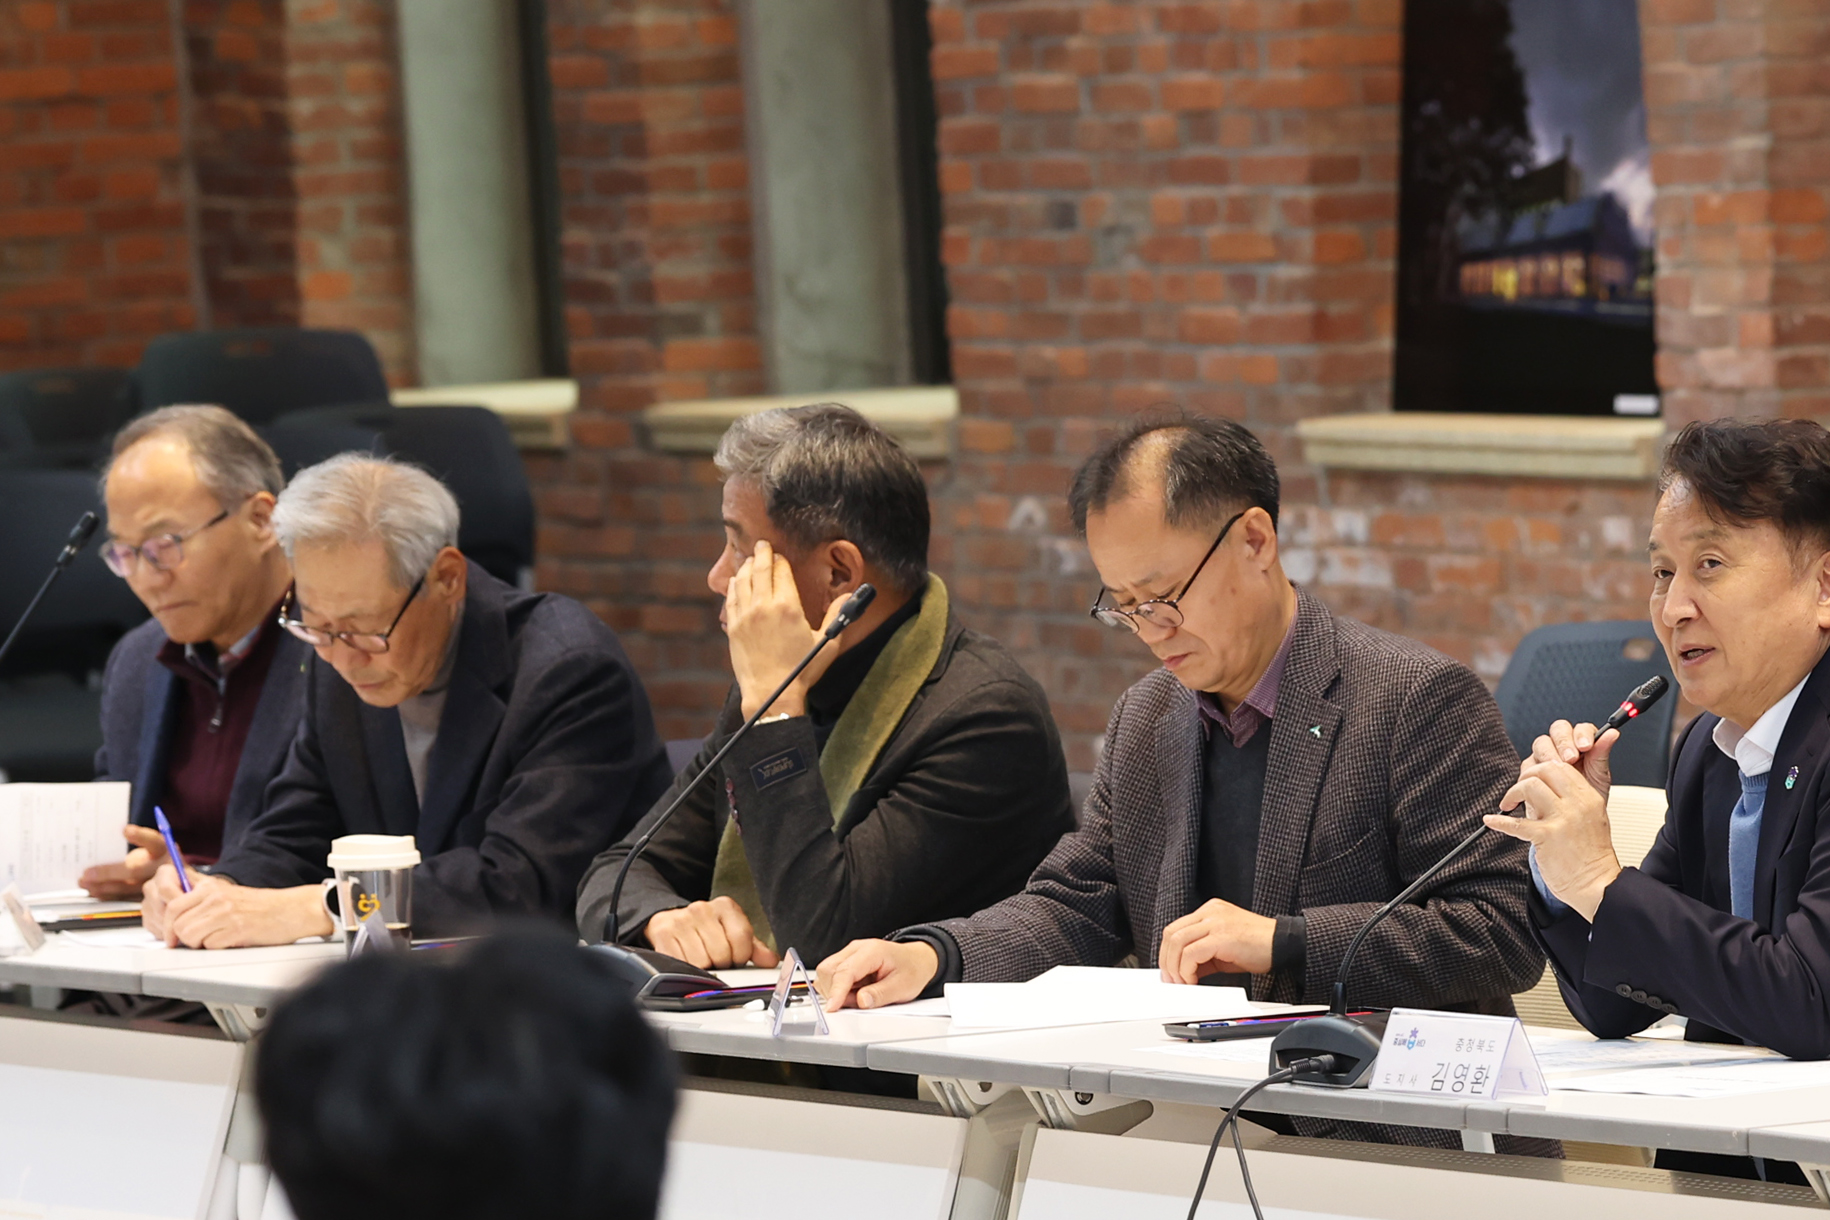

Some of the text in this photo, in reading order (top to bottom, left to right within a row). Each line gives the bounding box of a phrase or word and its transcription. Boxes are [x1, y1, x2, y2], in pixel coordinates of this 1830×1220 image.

[1455, 1038, 1496, 1053] 충청북도
[1383, 1073, 1418, 1087] 도지사
[1431, 1062, 1491, 1094] 김영환
